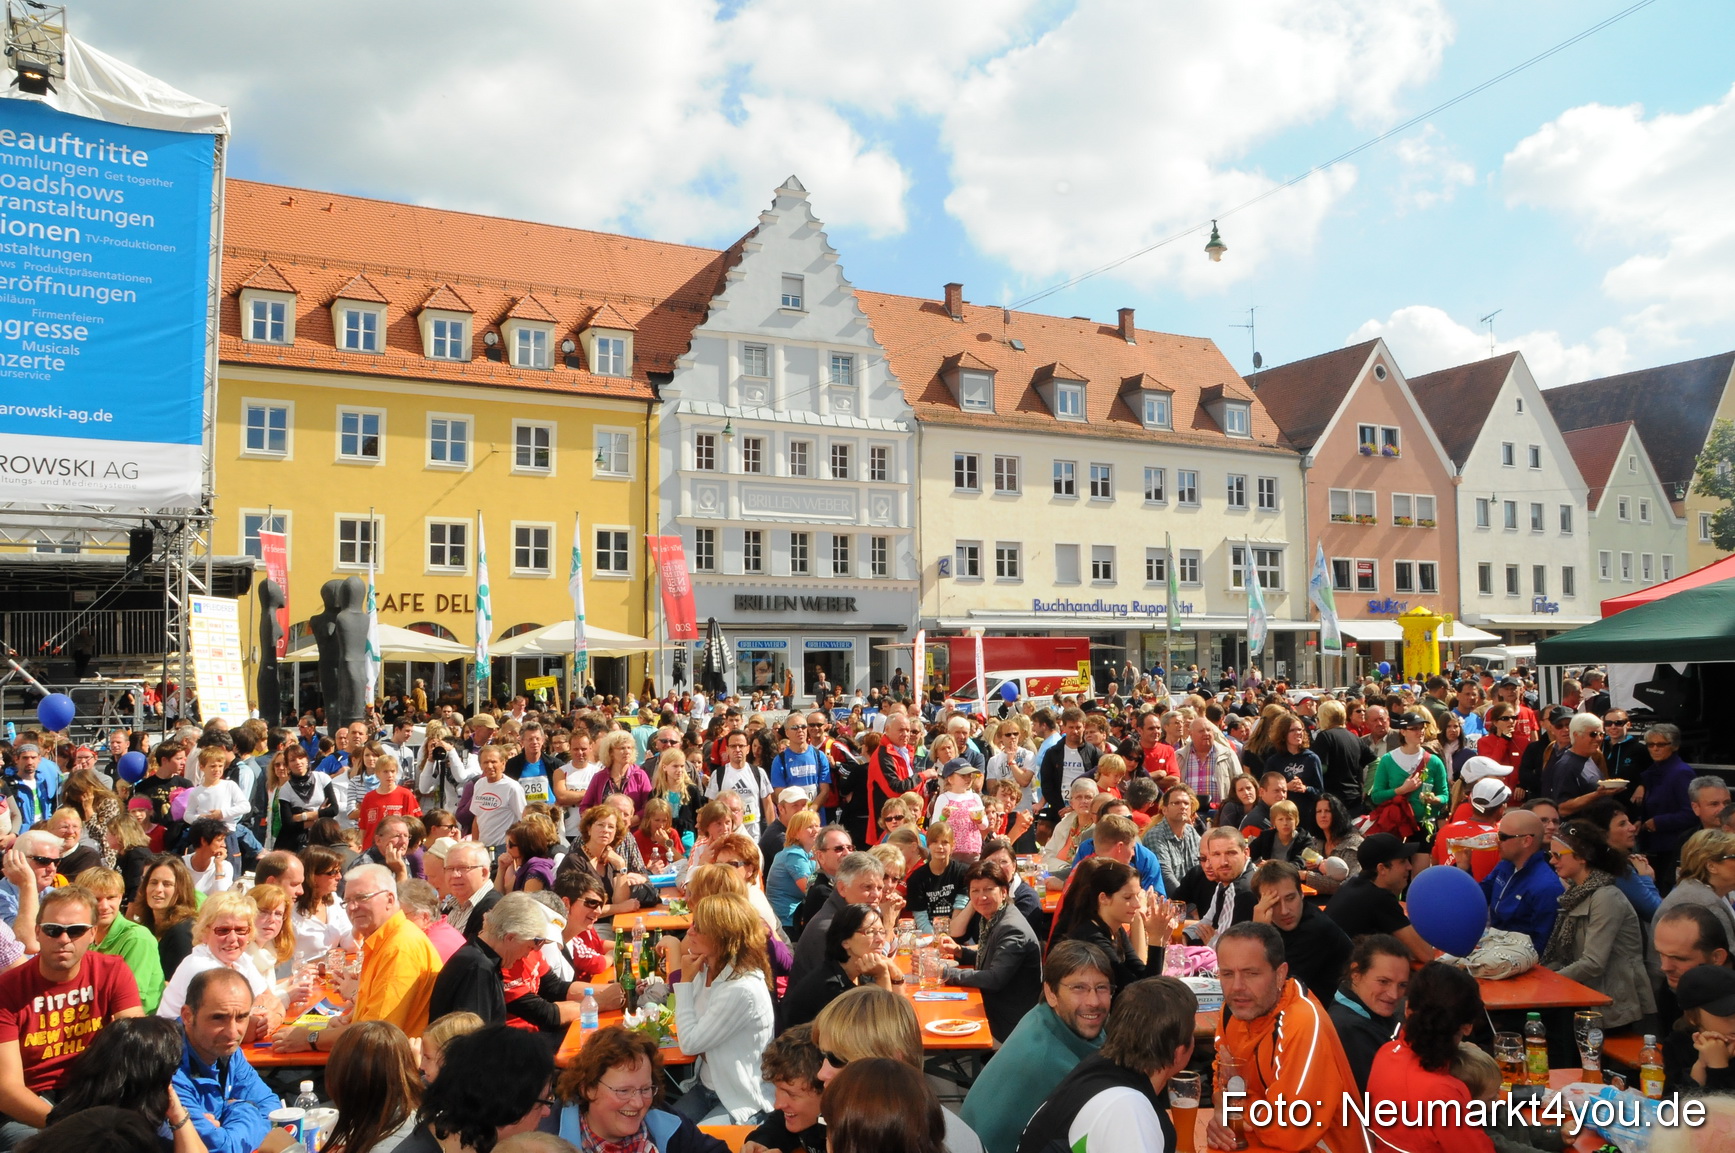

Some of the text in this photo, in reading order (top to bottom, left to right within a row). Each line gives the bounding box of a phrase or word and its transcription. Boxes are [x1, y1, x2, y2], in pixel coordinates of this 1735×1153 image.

[0, 129, 149, 167] eauftritte
[0, 173, 124, 203] oadshows
[104, 170, 174, 189] Get together
[0, 213, 176, 253] ionen TV-Produktionen
[24, 261, 152, 284] Produktpräsentationen
[32, 308, 104, 324] Firmenfeiern
[0, 318, 88, 341] gresse
[22, 340, 80, 356] Musicals
[0, 404, 113, 423] arowski-ag.de
[103, 461, 139, 480] AG
[40, 478, 59, 486] und
[62, 479, 137, 490] Mediensysteme
[748, 493, 850, 512] BRILLEN WEBER
[734, 594, 859, 612] BRILLEN WEBER
[1033, 598, 1193, 617] Buchhandlung Rupprht
[740, 641, 785, 649] BRILLEN WEBER
[807, 641, 851, 649] BRILLEN WEBER
[1081, 668, 1088, 680] A
[524, 783, 543, 794] 263
[33, 985, 95, 1013] FITCH
[39, 1004, 91, 1029] 1892
[24, 1016, 104, 1047] NEW YORK
